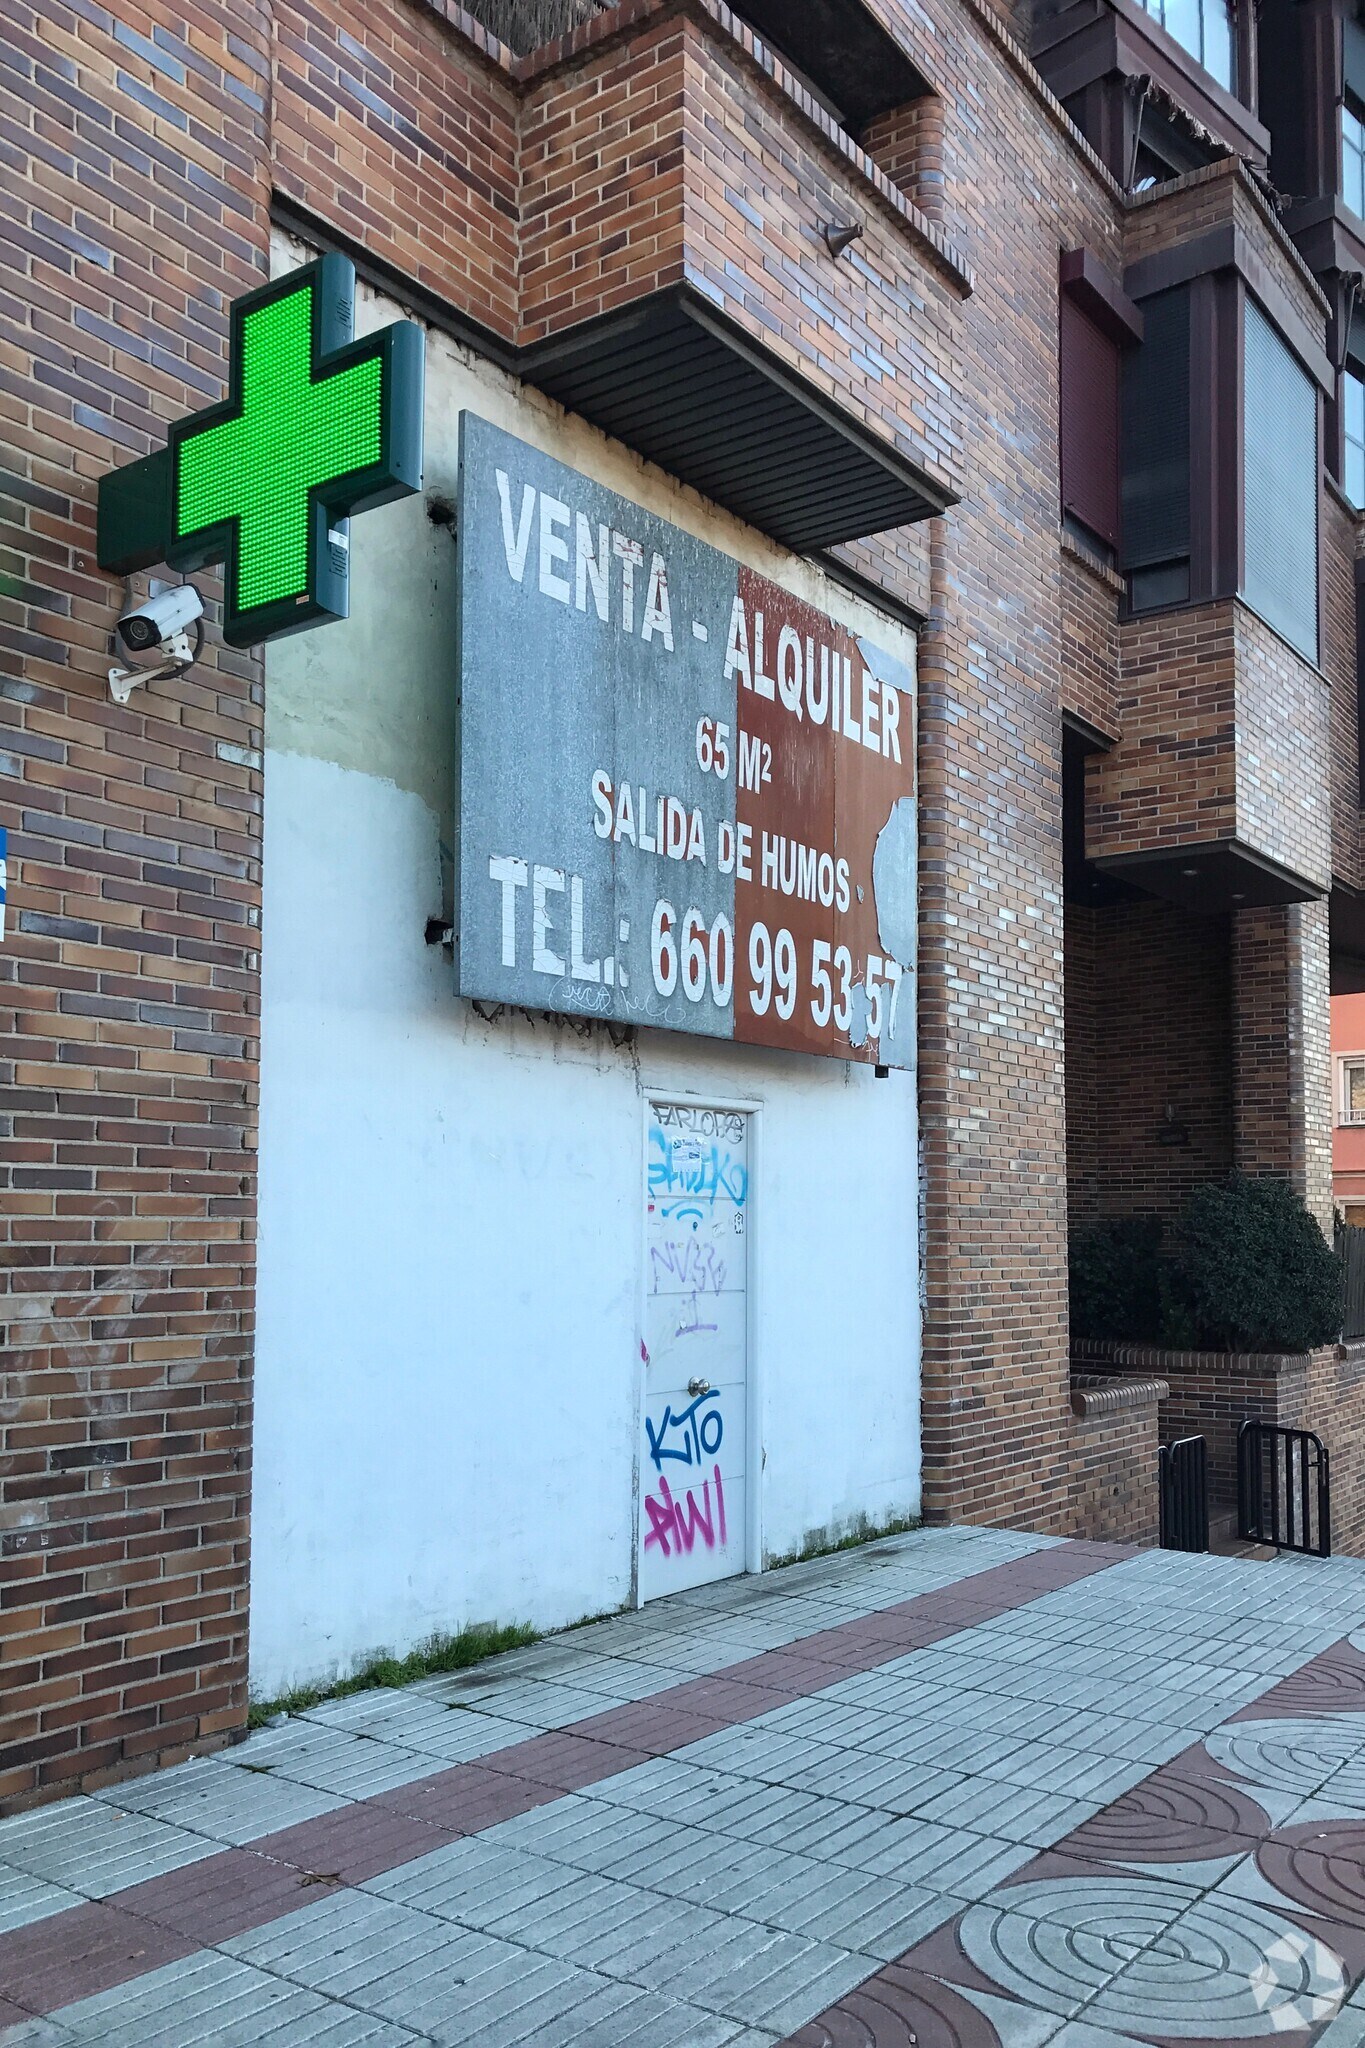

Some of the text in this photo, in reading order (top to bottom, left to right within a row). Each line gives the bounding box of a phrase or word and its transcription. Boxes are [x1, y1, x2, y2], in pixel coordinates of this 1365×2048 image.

[495, 468, 902, 765] VENTA - ALQUILER
[696, 714, 730, 780] 65
[592, 769, 850, 913] SALIDA DE HUMOS
[651, 898, 734, 1007] 660
[749, 922, 797, 1020] 99
[810, 939, 852, 1032] 53
[866, 954, 903, 1041] 57
